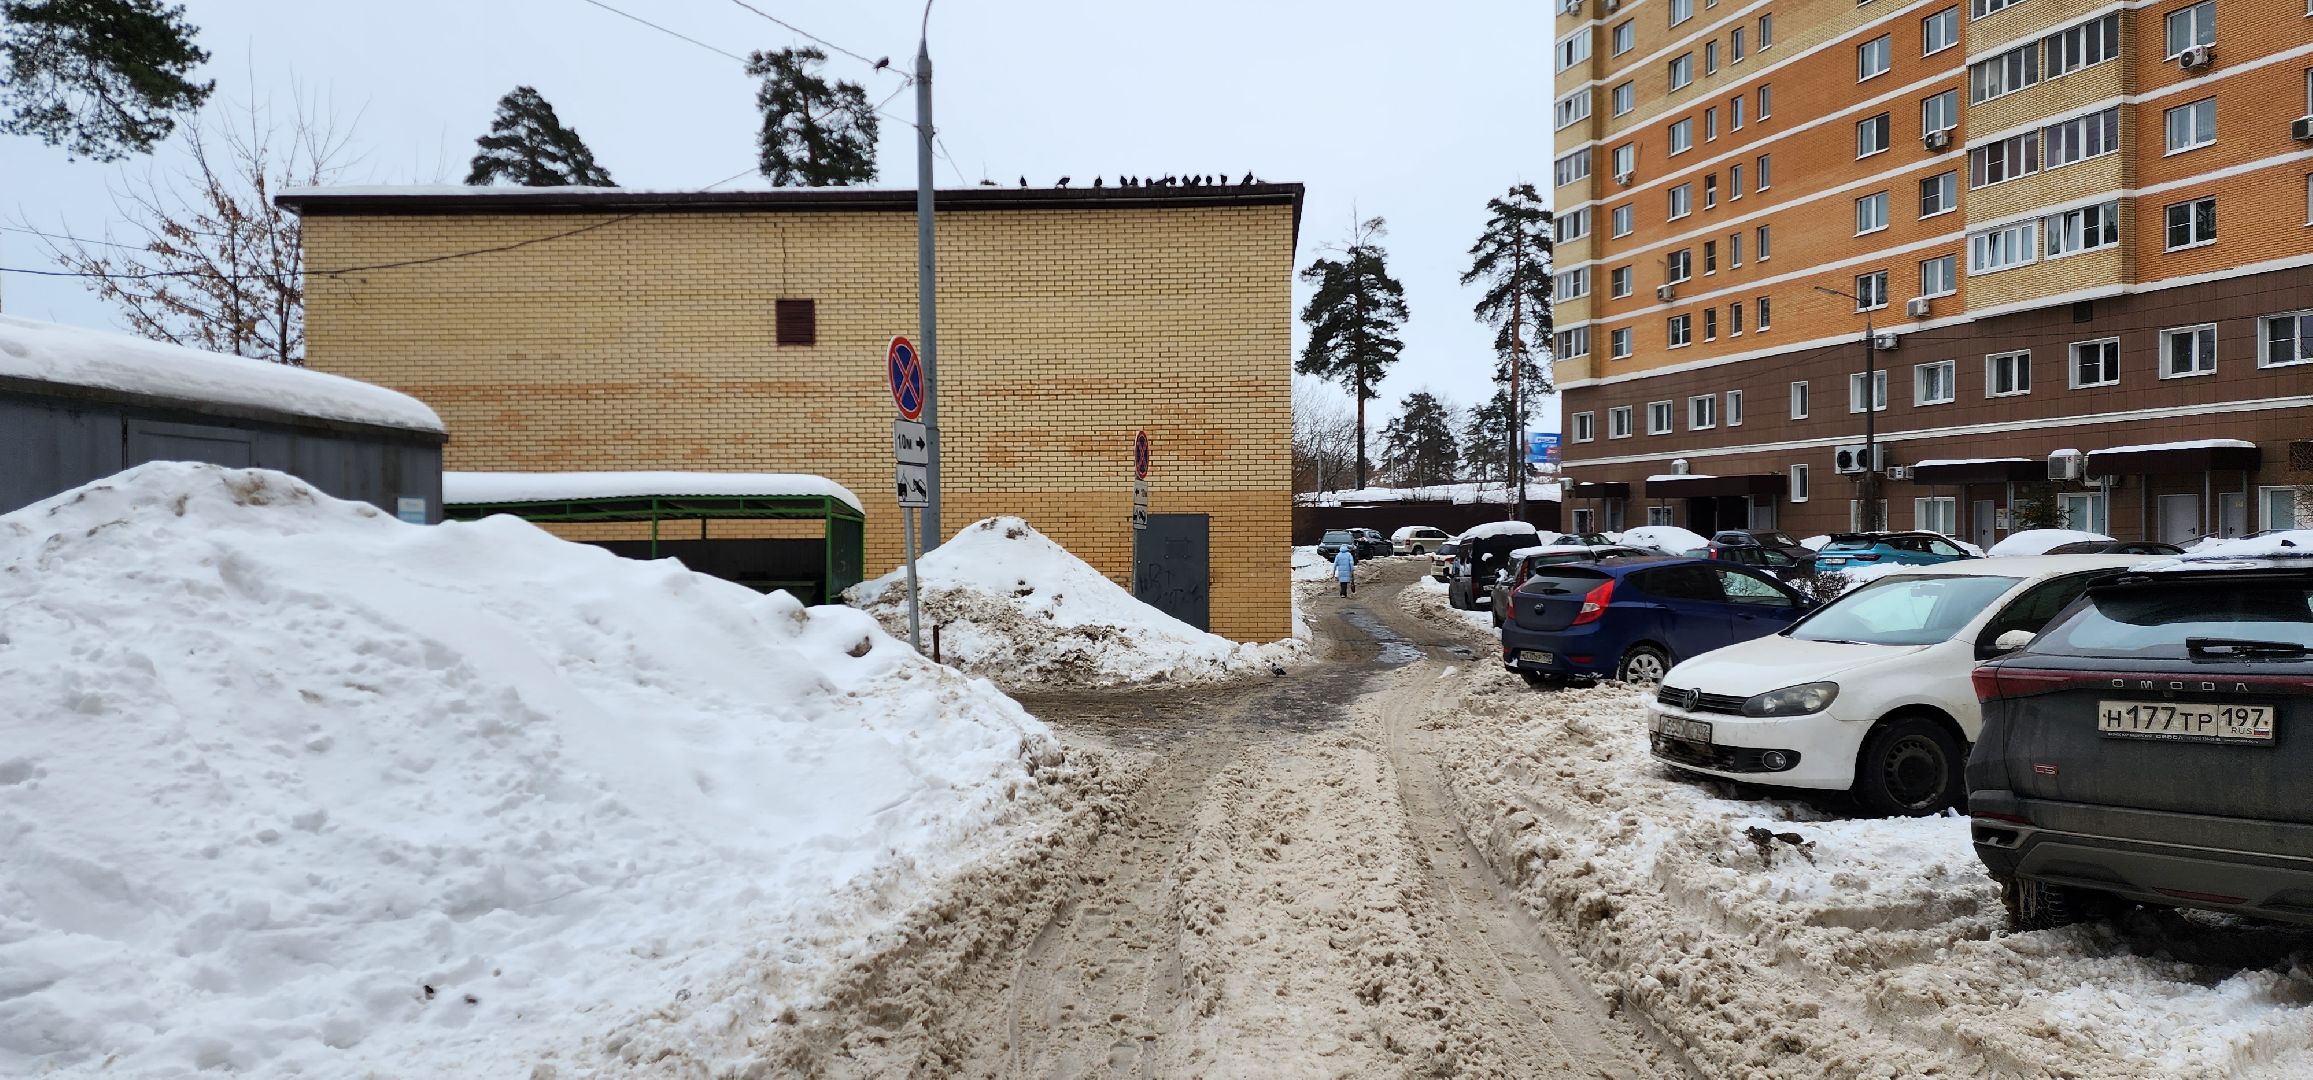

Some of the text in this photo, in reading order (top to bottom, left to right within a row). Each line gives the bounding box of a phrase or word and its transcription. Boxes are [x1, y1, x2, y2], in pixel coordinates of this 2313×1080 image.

[897, 433, 912, 449] 10м
[2111, 678, 2248, 692] OMODA
[2221, 707, 2264, 728] 197
[2231, 727, 2253, 735] RUS
